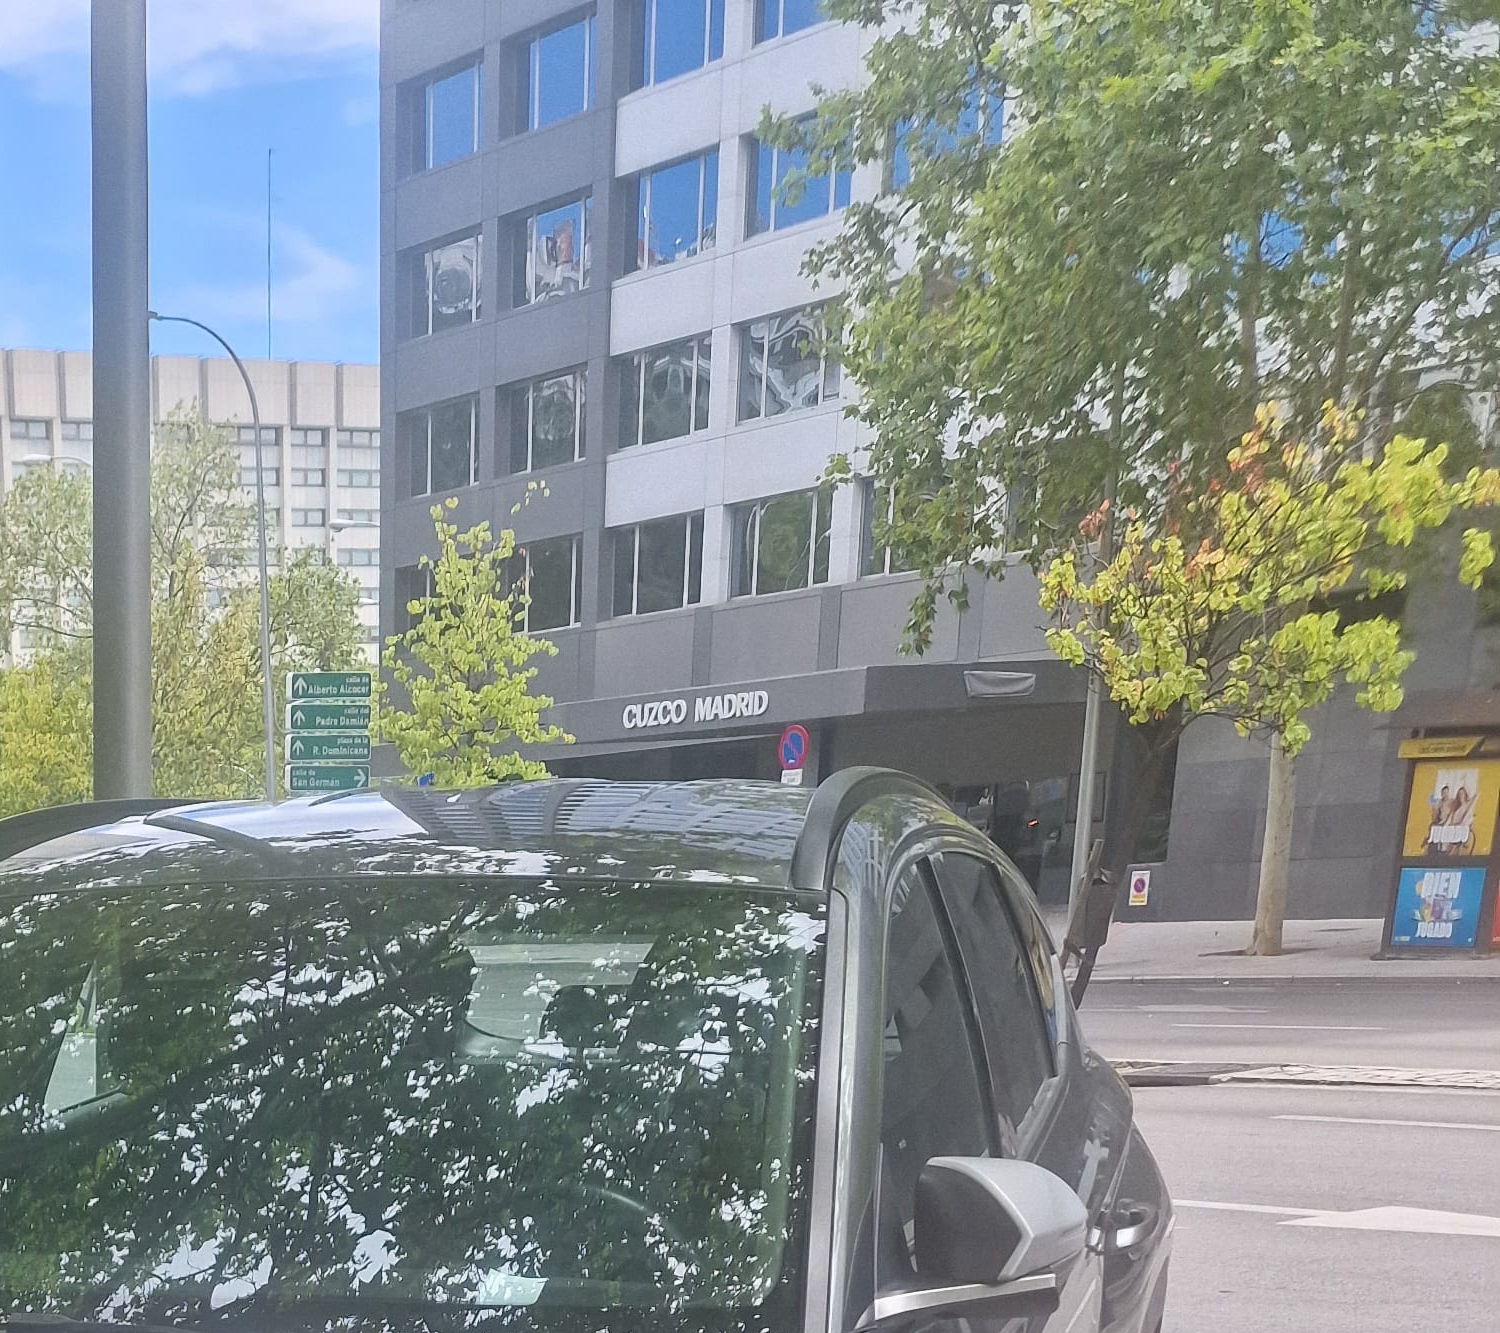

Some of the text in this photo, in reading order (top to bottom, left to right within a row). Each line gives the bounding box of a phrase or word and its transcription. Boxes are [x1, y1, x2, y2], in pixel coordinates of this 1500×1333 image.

[307, 684, 369, 694] Alberto Alcocer
[622, 690, 768, 729] CUZCO MADRID
[315, 717, 338, 726] Padre
[313, 745, 368, 755] R. Dominicana
[292, 778, 305, 786] San
